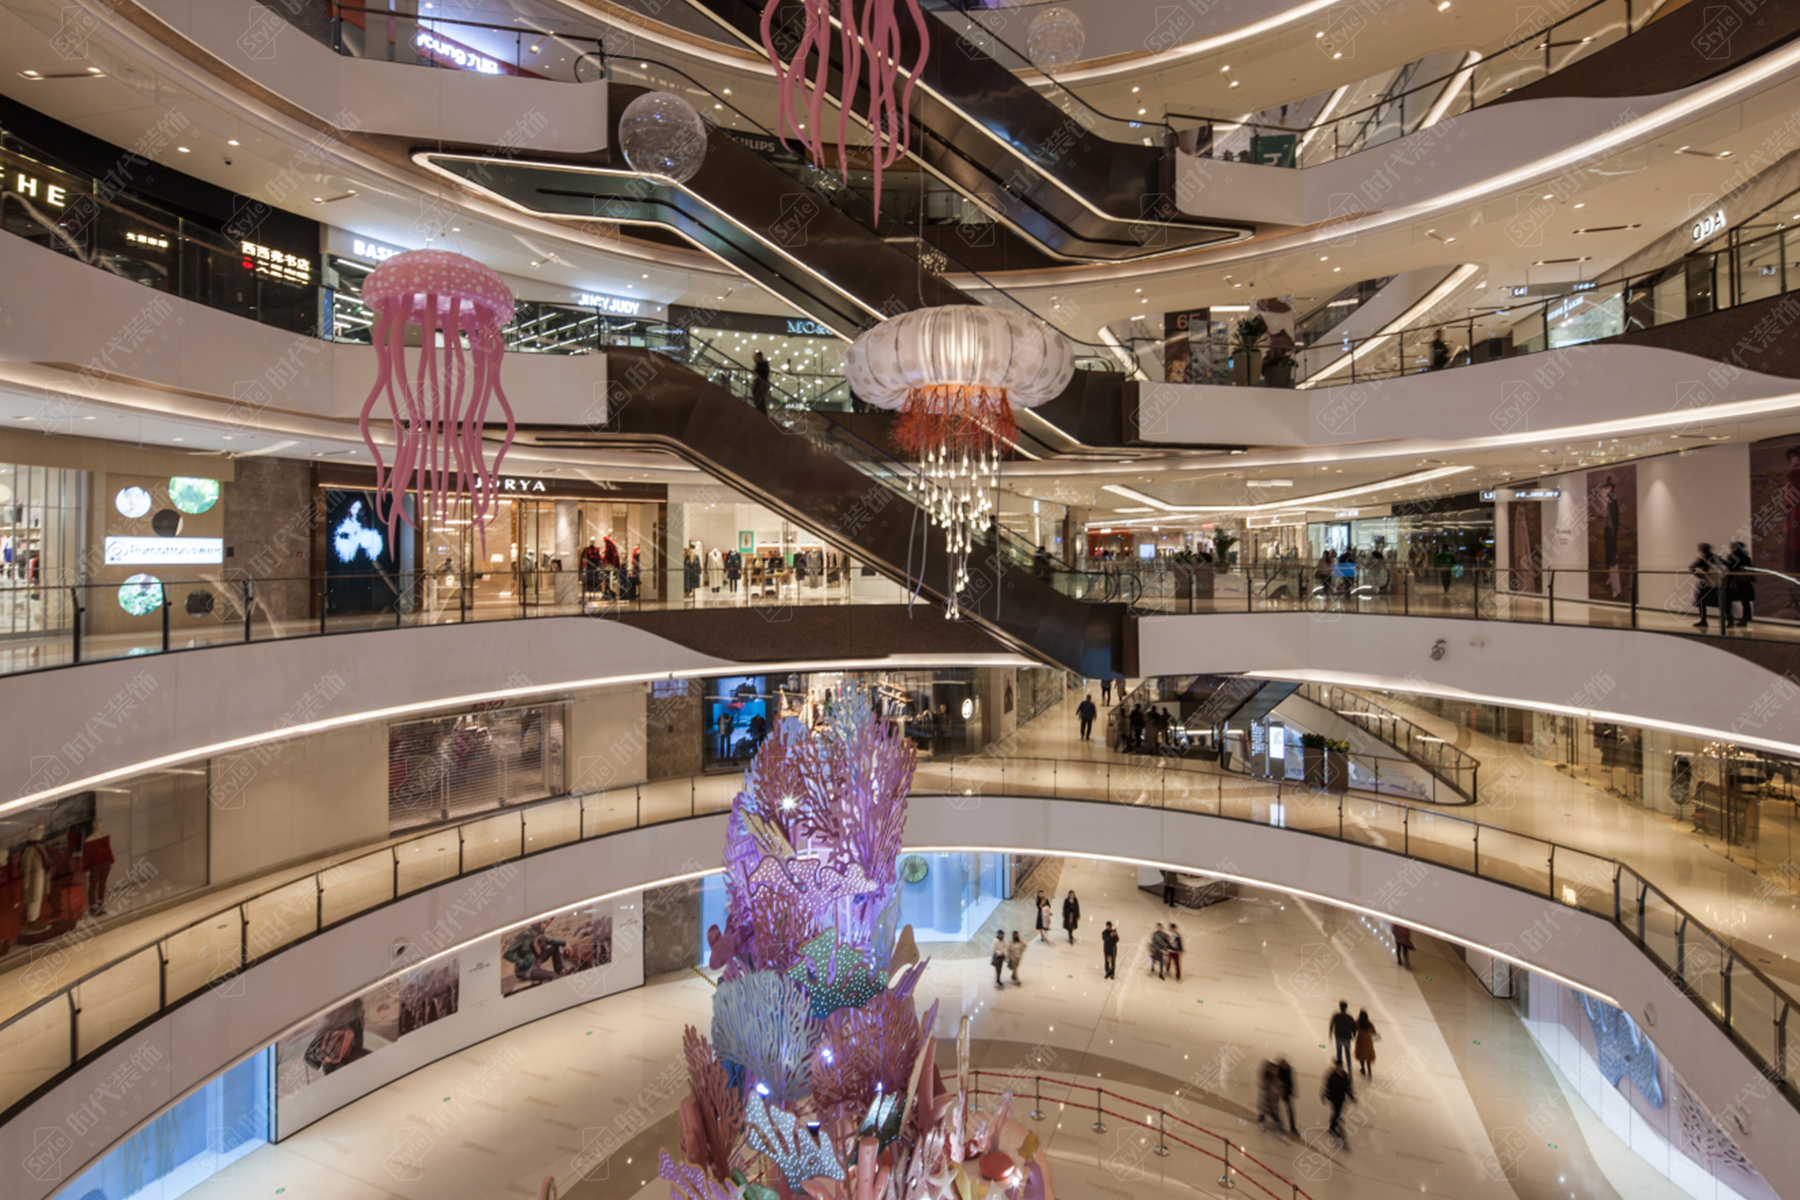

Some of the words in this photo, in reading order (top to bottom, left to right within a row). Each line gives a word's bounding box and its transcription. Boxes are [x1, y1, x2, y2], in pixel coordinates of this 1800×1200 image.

[241, 240, 310, 272] 西西弗书店
[609, 298, 640, 315] JUDY
